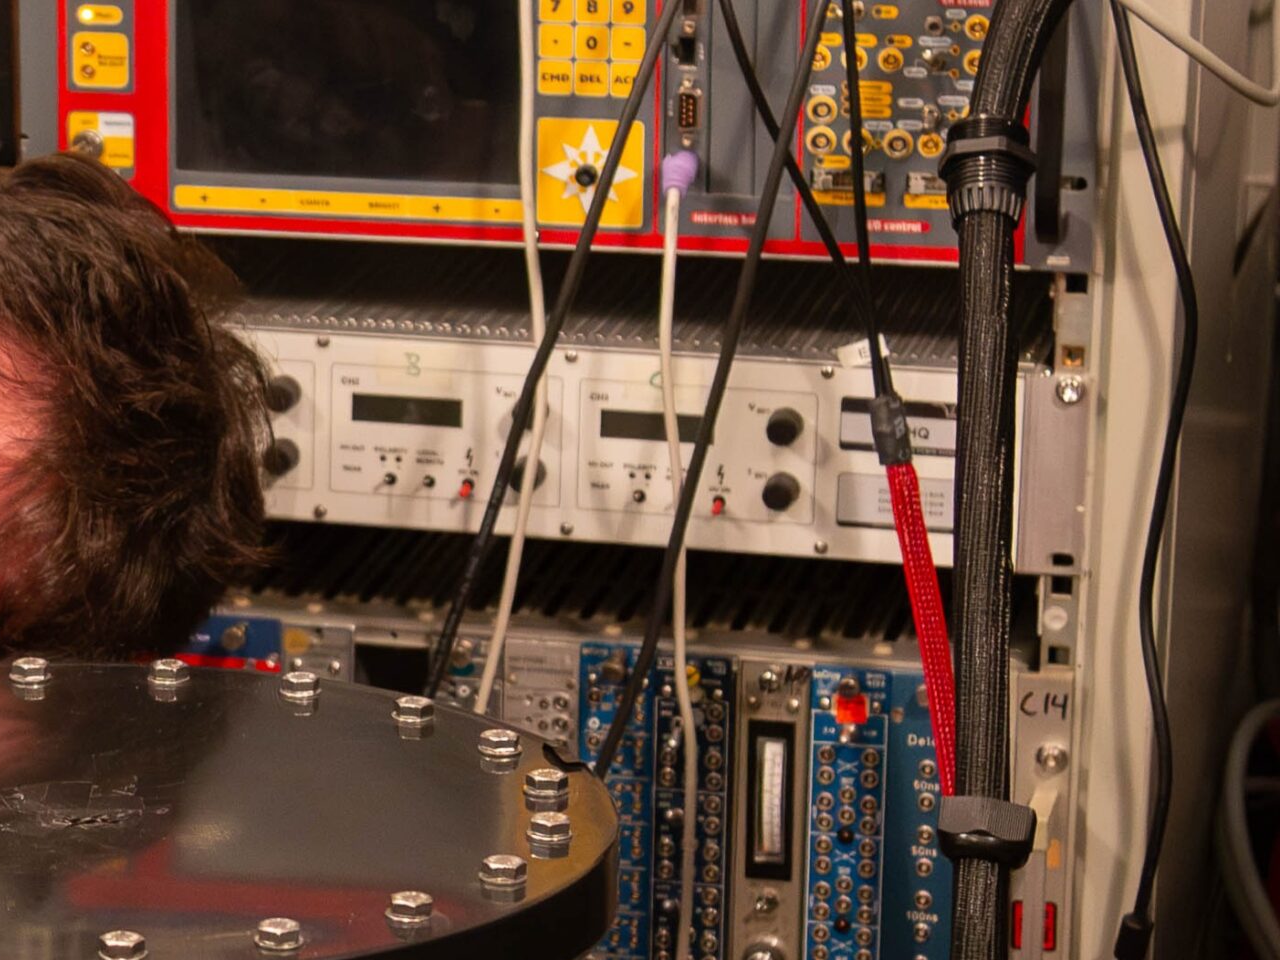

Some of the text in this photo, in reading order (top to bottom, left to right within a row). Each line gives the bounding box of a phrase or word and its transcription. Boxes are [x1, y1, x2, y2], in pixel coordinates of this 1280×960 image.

[549, 0, 562, 13] 7
[622, 0, 635, 15] 9
[541, 71, 570, 82] CMD
[579, 73, 603, 84] DEL
[614, 75, 637, 85] AC
